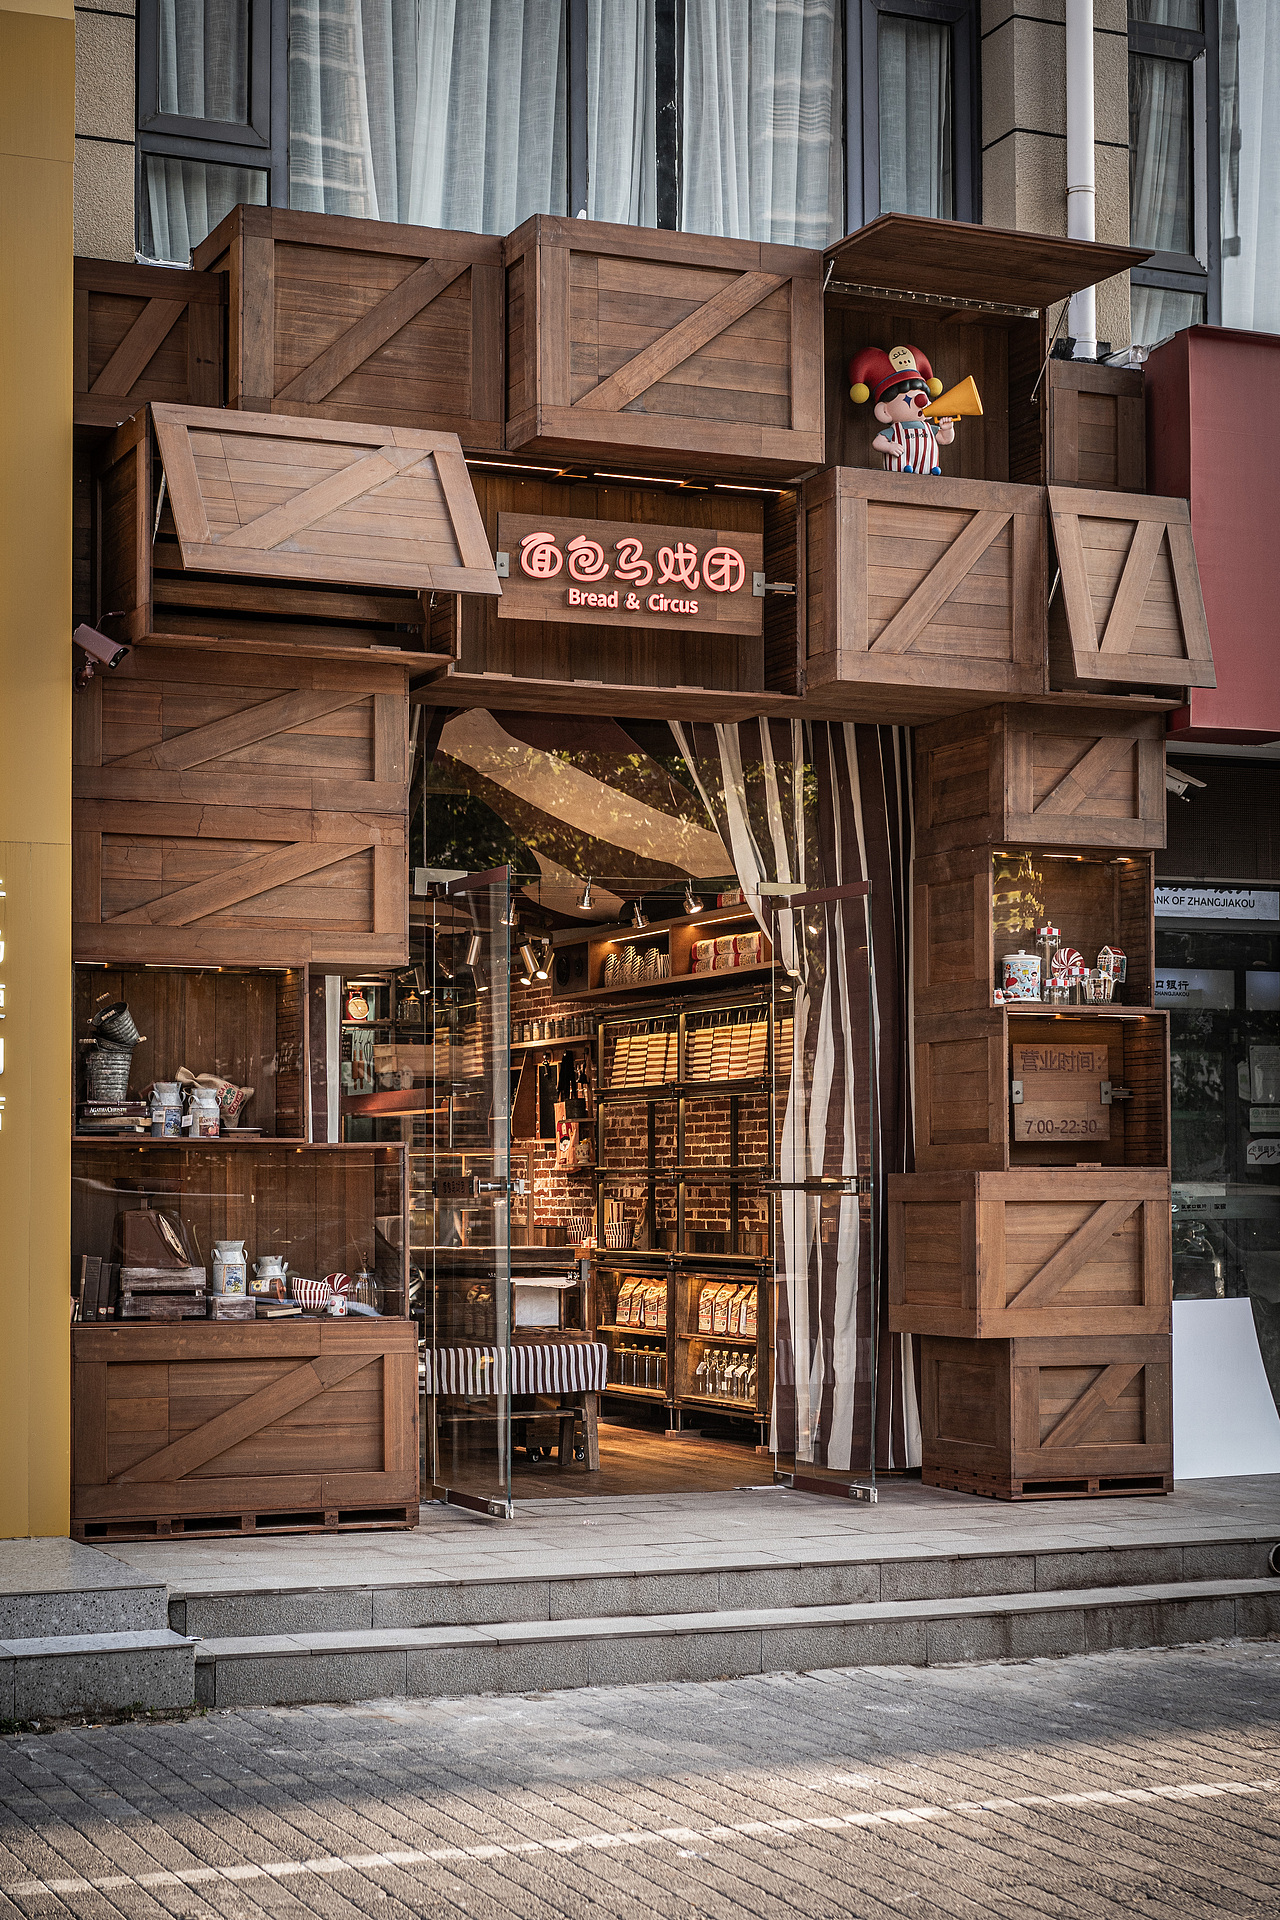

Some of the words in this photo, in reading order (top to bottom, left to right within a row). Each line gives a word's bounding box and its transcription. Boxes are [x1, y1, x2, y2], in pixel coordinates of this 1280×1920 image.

[520, 532, 746, 593] 面包马戏团
[567, 588, 619, 609] Bread
[623, 591, 641, 610] &
[646, 593, 699, 615] Circus
[1171, 896, 1186, 905] OF
[1187, 896, 1255, 909] ZHANGJIAKOU
[1020, 1049, 1101, 1072] 营业时间：
[1025, 1119, 1097, 1134] 7:00-22:30
